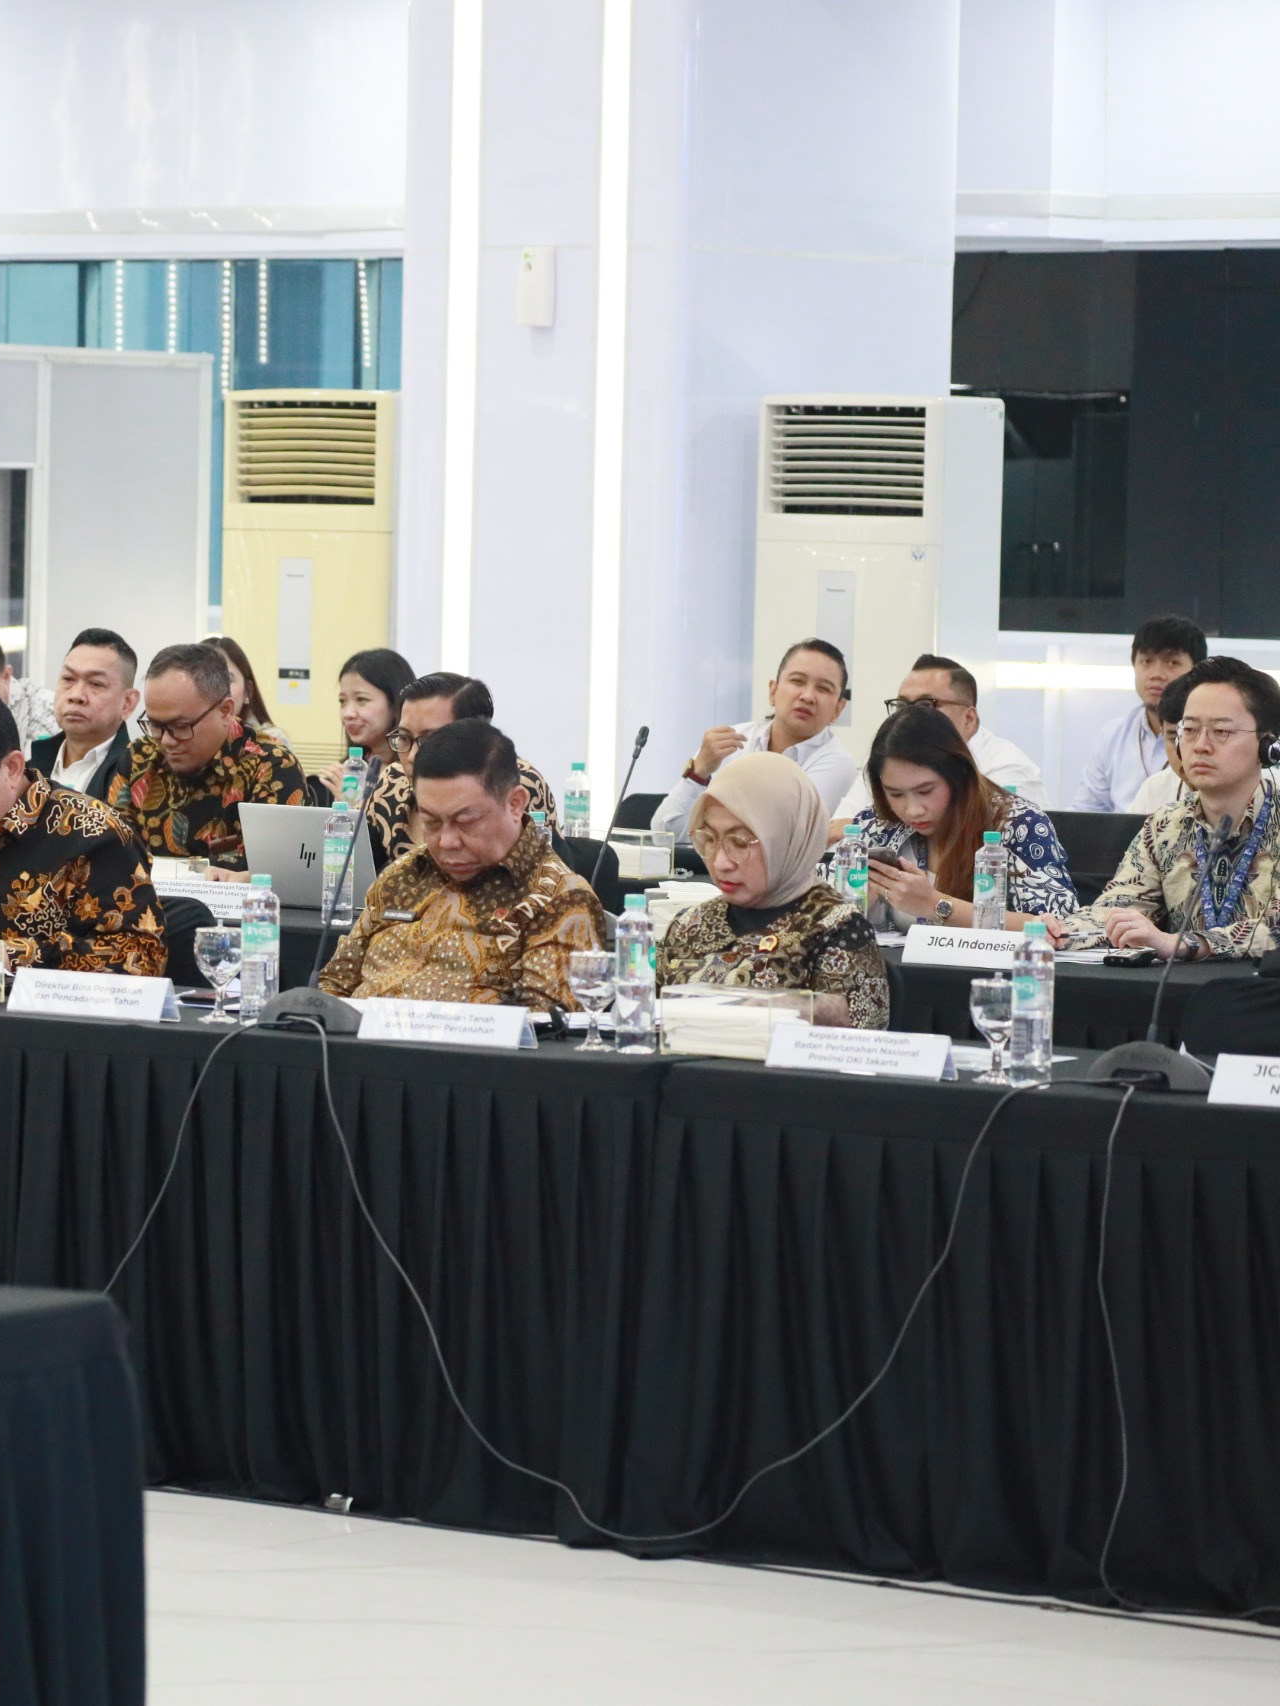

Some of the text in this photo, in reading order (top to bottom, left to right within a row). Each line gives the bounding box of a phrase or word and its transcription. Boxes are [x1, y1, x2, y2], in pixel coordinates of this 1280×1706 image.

[927, 936, 1016, 952] JICA Indonesia
[34, 981, 143, 996] Direktur Bina Pengadaan
[33, 991, 140, 1007] dan Pencadangan Tahan
[469, 1014, 495, 1024] Tanah
[444, 1023, 495, 1035] Pertanahan
[808, 1031, 910, 1047] Kepala Kantor Wilayah
[794, 1041, 920, 1058] Badan Pertanahan Nasional
[808, 1053, 899, 1067] Provinsi DKI Jakarta
[1253, 1063, 1280, 1077] JIC
